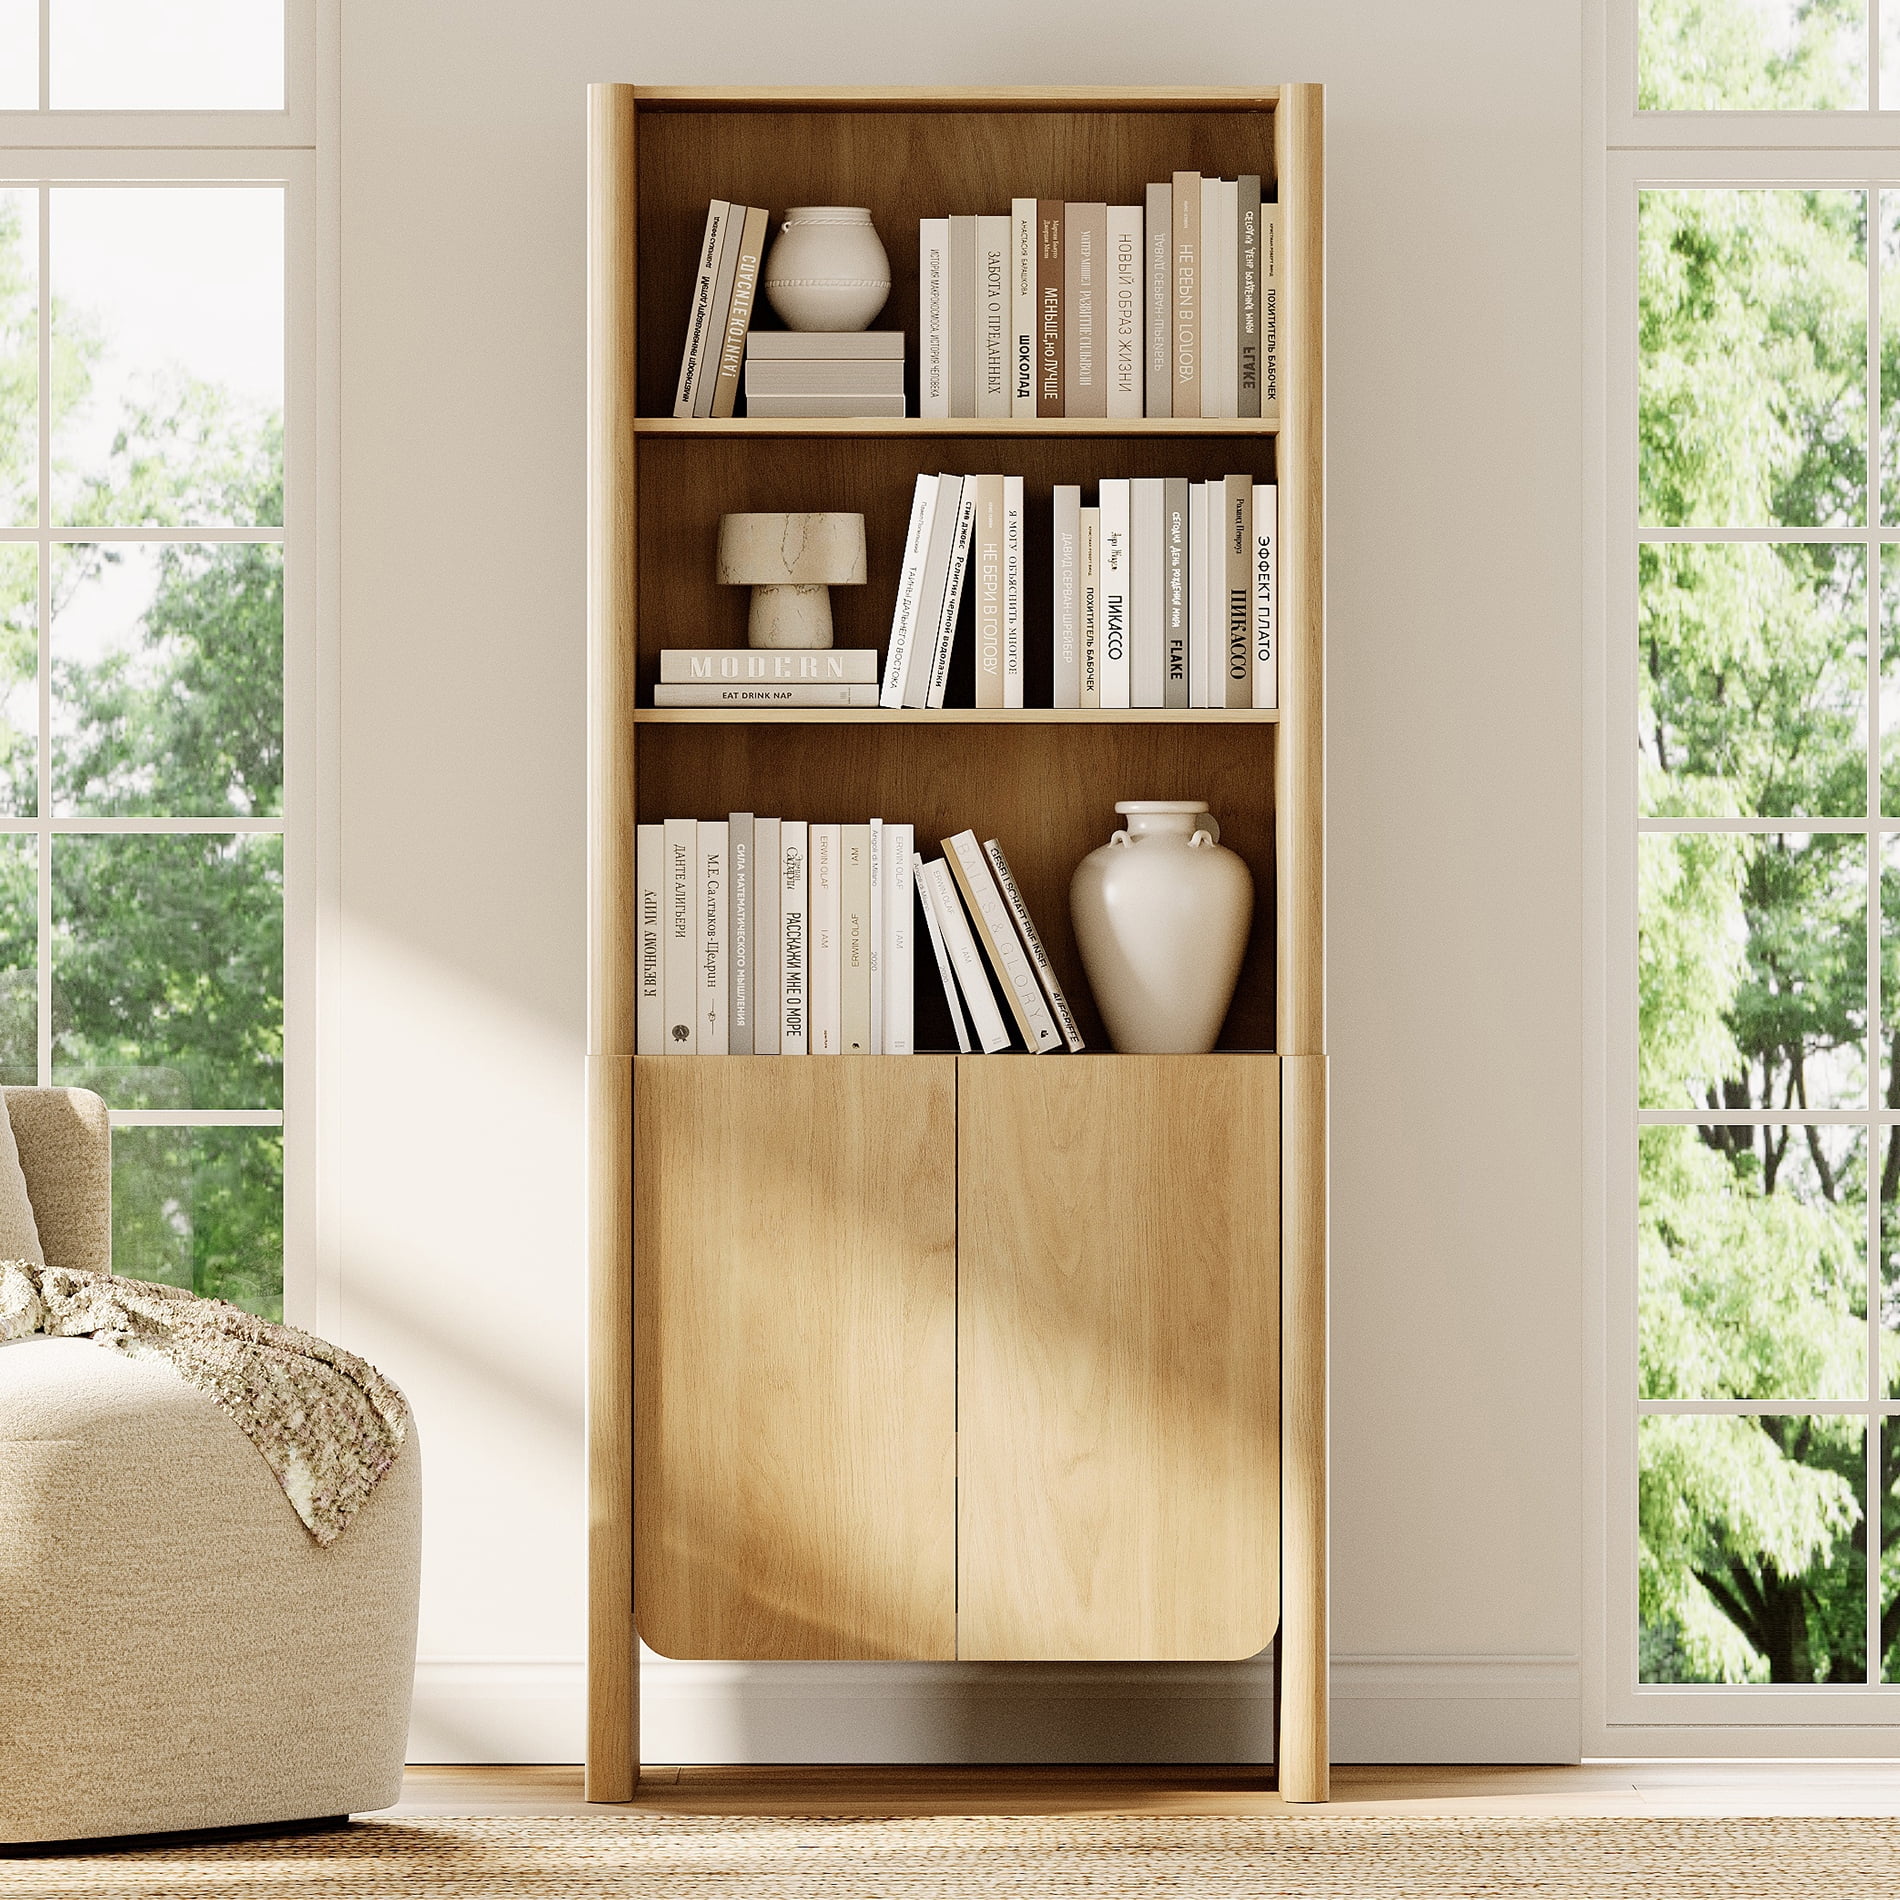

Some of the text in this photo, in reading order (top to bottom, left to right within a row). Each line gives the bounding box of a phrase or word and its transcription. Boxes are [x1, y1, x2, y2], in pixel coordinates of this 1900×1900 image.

[930, 249, 940, 278] ИСТОРИЯ
[1020, 220, 1028, 296] АНАСТАСИЯ БАРАШКОВА
[986, 250, 1001, 394] ЗАБОТА О ПРЕДАННЫХ
[1119, 234, 1134, 392] НОВЫЙ ОБРАЗ ЖИЗНИ
[930, 334, 940, 364] ИСТОРИЯ
[1017, 334, 1030, 398] ШОКОЛАД
[1267, 288, 1276, 400] ПОХИТИТЕЛЬ БАБОЧЕК
[930, 365, 940, 398] ЧЕЛОВЕКА
[1043, 359, 1058, 400] ЛУЧШЕ
[1008, 520, 1017, 552] МОГУ
[1170, 546, 1181, 566] ДЕНЬ
[984, 543, 998, 675] НЕ БЕРИ В ГОЛОВУ
[1008, 556, 1017, 624] ОБЪЯСНИТЬ
[1061, 532, 1074, 664] ДАВИД СЕРВАН-ШРЕЙБЕР
[1258, 536, 1270, 662] ЭФФЕКТ ПЛАТО
[897, 598, 913, 646] ДАЛЬНЕГО
[935, 556, 965, 687] Религия черной водолазки
[1086, 587, 1094, 691] ПОХИТИТЕЛЬ БАБОЧЕК
[1108, 595, 1123, 660] ПИКАССО
[1171, 607, 1181, 628] МИРА
[1230, 589, 1246, 680] ПИКАССО
[689, 656, 844, 678] MODERN
[890, 647, 904, 689] ВОСТОКА
[1008, 628, 1017, 675] МНОГОЕ
[1170, 640, 1182, 680] FLAKE
[722, 691, 792, 700] EAT DRINK NAP
[820, 836, 828, 889] ERWIN OLAF
[851, 847, 859, 863] AM
[896, 836, 904, 890] ERWIN OLAF
[674, 844, 686, 938] ДАНТЕ АЛИГЬЕРИ
[644, 889, 656, 998] К ВЕЧНОМУ МИРУ
[704, 854, 720, 988] М.Е. Салтыков-Щедрин
[736, 844, 746, 1026] СИЛА МАТЕМАТИЧЕСКОГО МЫШЛЕНИЯ
[786, 912, 802, 968] РАССКАЖИ
[821, 934, 828, 949] AM
[851, 913, 859, 968] ERWIN OLAF
[896, 934, 904, 950] AM
[786, 972, 802, 994] МНЕ
[1000, 942, 1044, 1019] GLORY
[786, 1008, 802, 1036] МОРЕ
